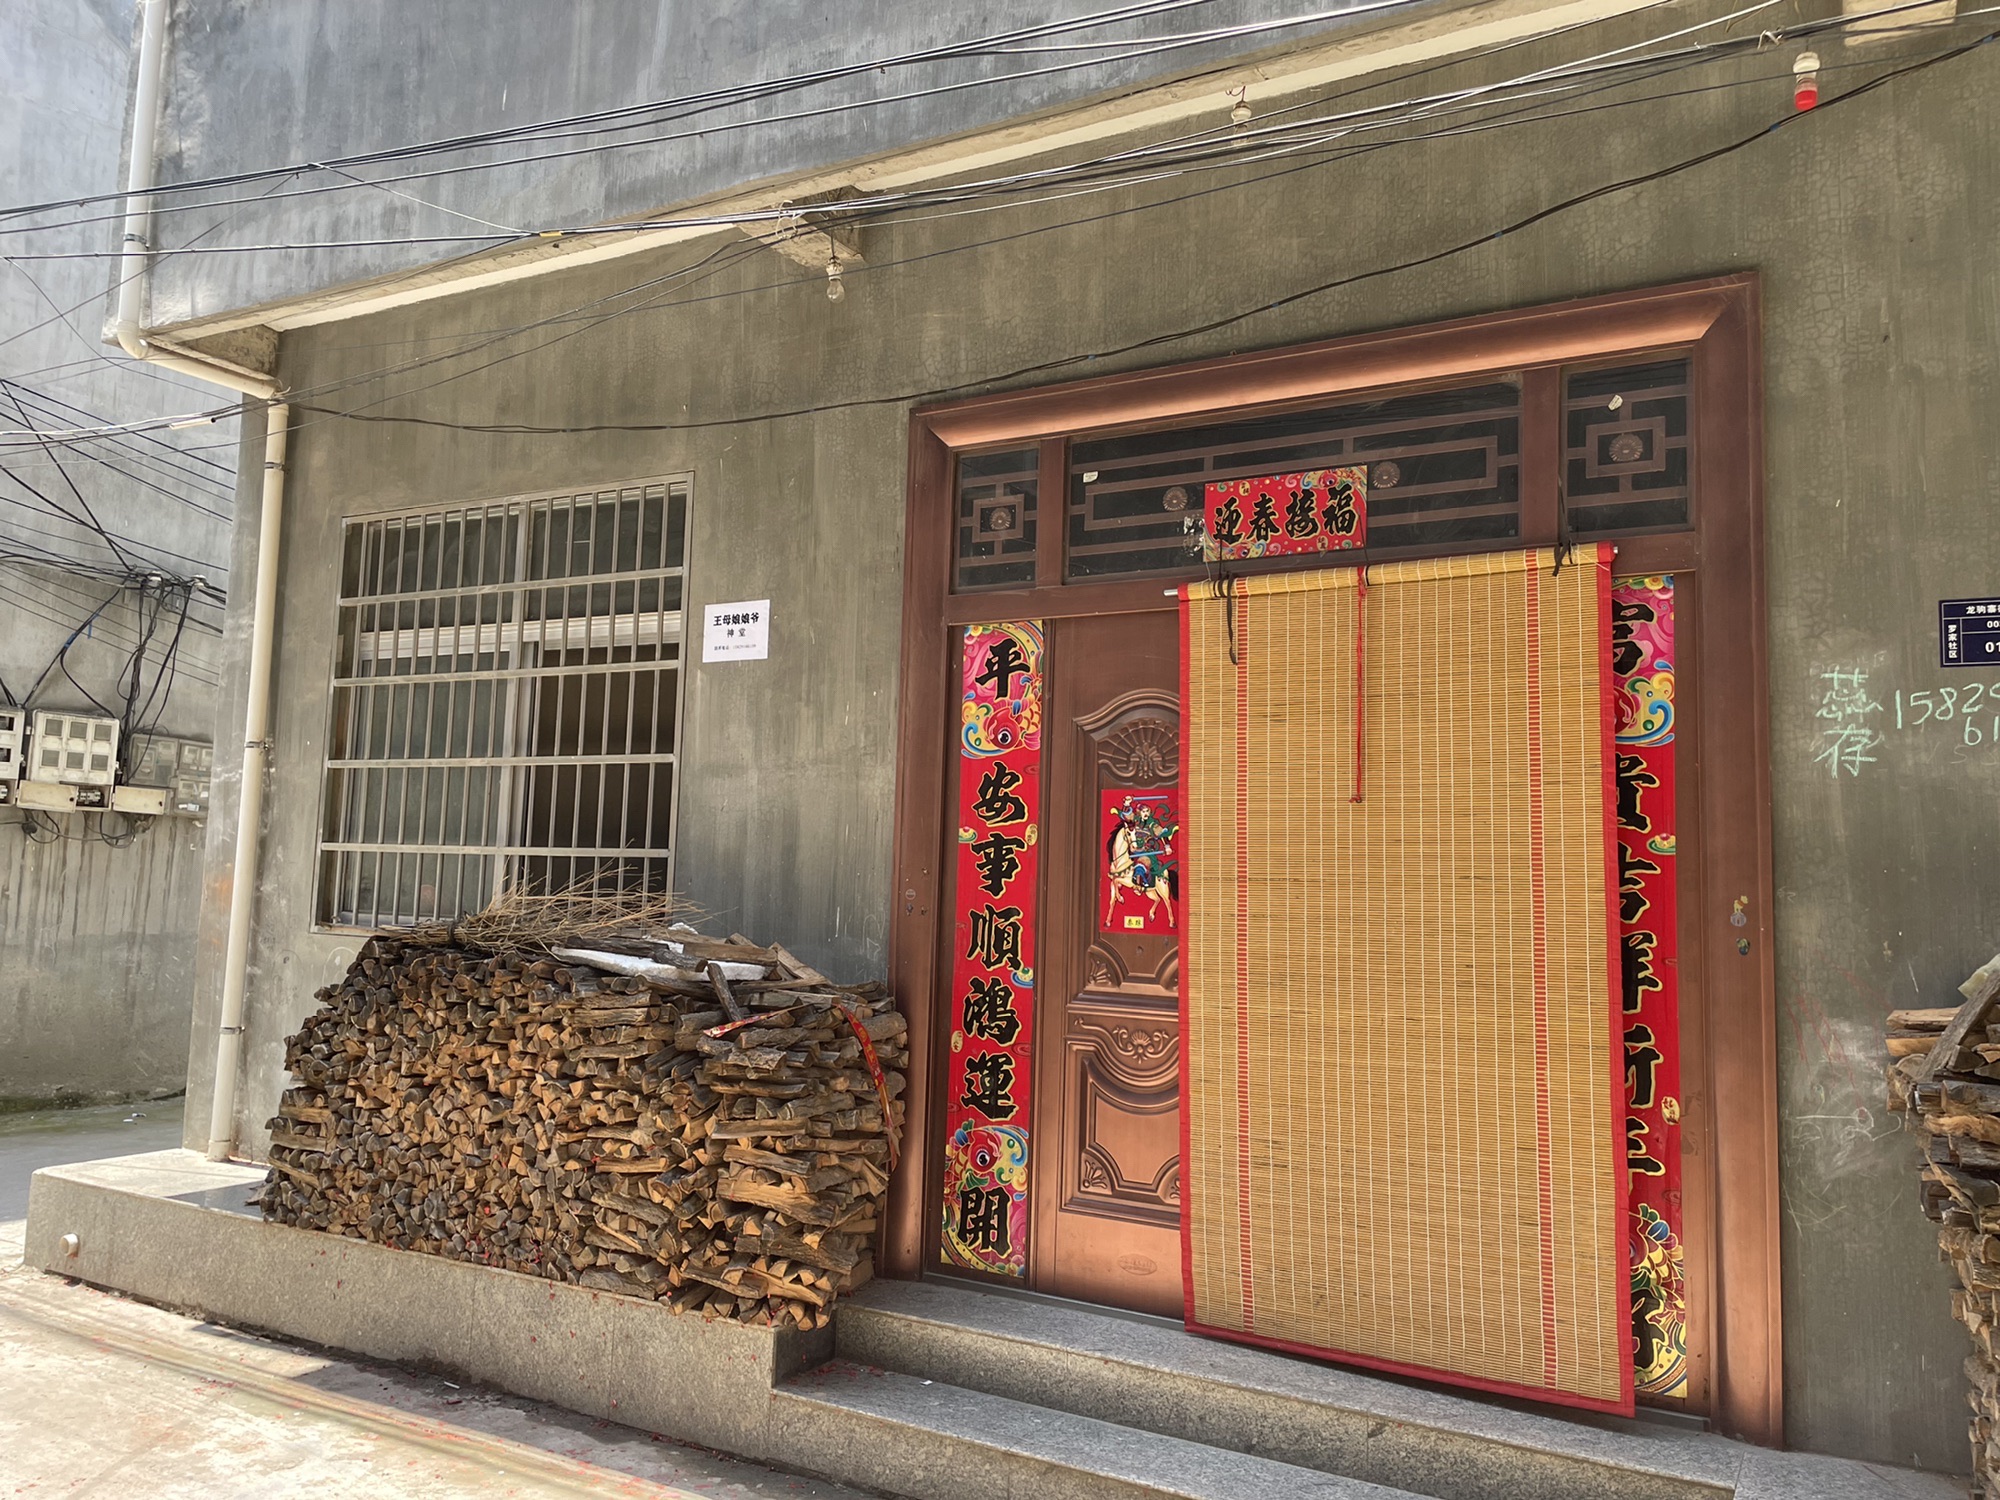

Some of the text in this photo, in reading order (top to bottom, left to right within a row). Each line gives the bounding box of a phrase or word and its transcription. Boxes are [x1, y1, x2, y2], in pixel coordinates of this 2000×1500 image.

[1213, 483, 1357, 545] 迎春接福
[1965, 604, 2000, 615] 龙驹寨
[1986, 620, 2000, 629] 00
[1947, 624, 1958, 659] 罗家社区
